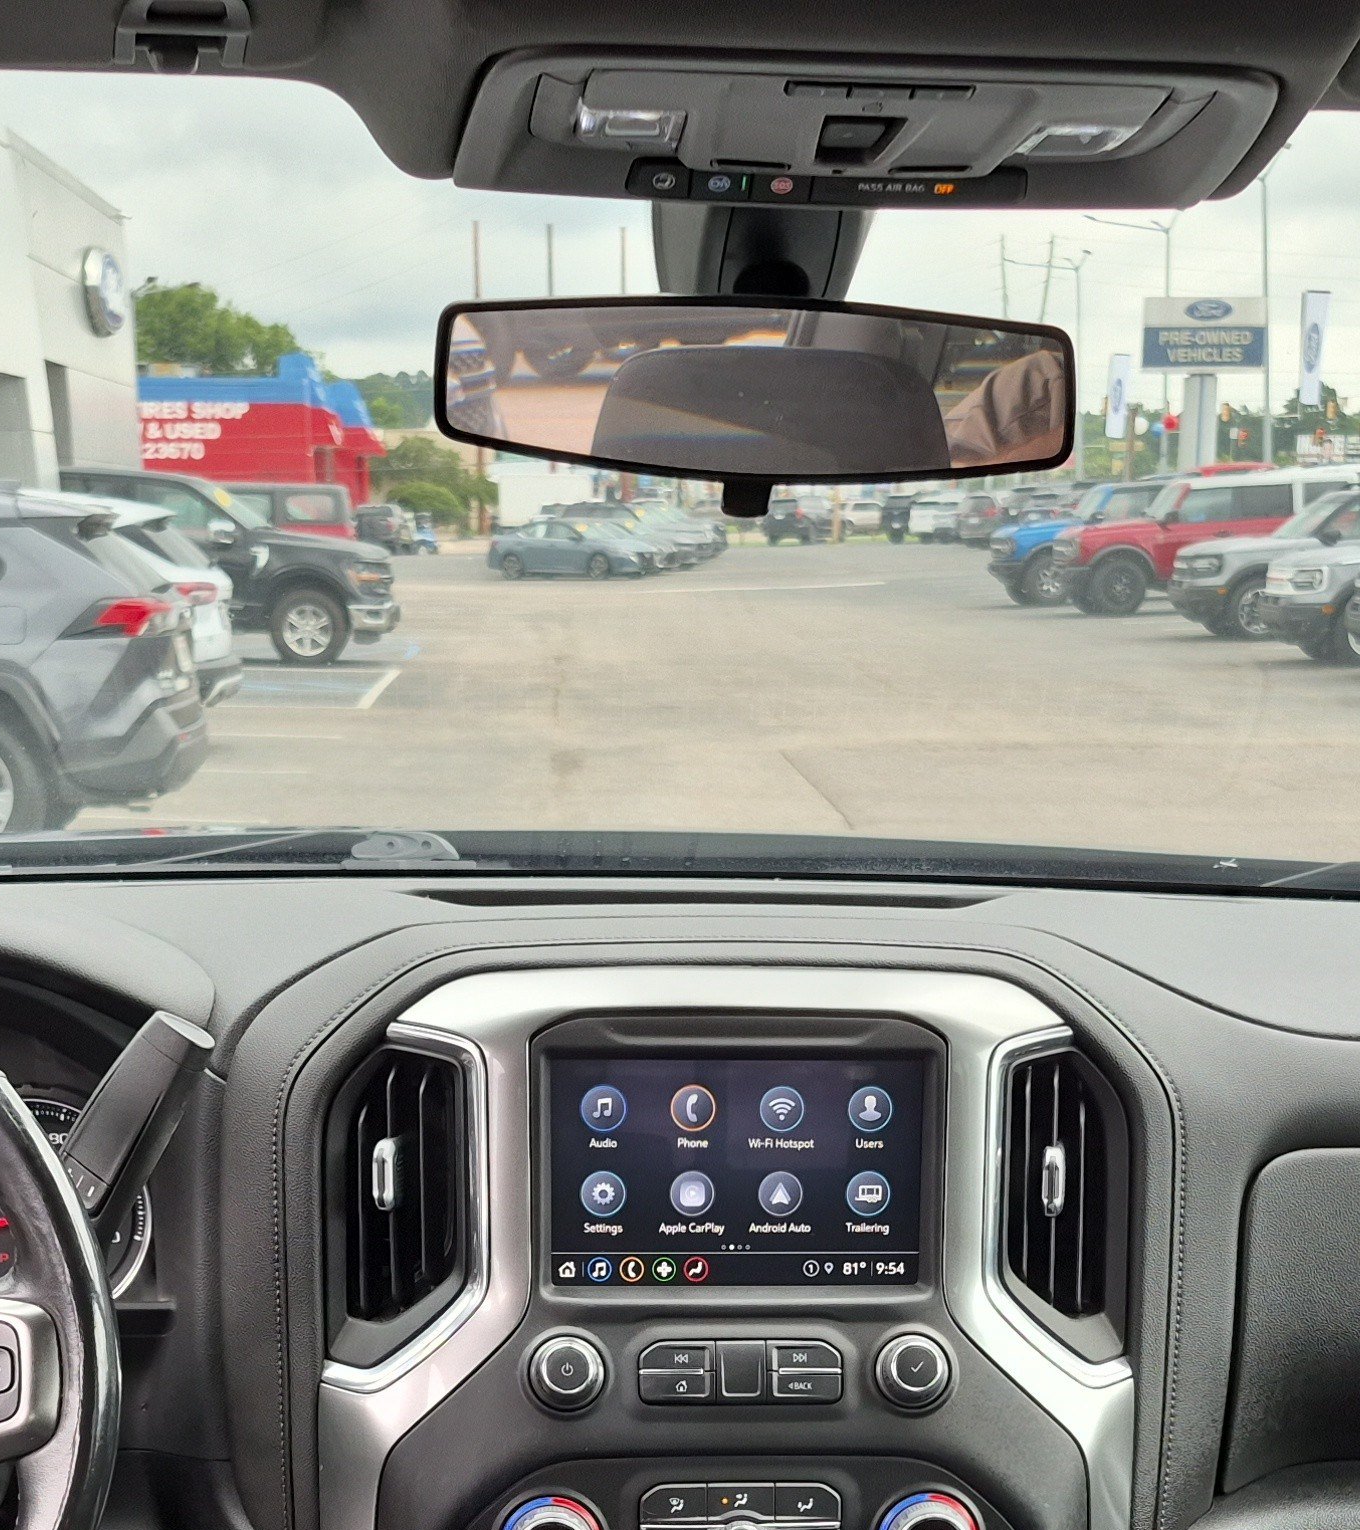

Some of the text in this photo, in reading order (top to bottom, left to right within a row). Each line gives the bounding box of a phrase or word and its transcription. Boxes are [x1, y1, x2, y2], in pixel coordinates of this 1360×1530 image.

[858, 183, 954, 195] PASS AIR BAG OFF
[1158, 331, 1254, 346] PRE-OWNED
[1167, 347, 1245, 363] VEHICLES
[190, 402, 250, 419] SHOP
[163, 422, 221, 440] USED
[589, 1138, 618, 1148] Audio
[677, 1138, 709, 1148] Phone
[748, 1138, 815, 1151] Wi-Fi Hotspot
[855, 1138, 884, 1149] Users
[583, 1222, 623, 1235] Settings
[659, 1222, 725, 1236] Apple CarPlay
[749, 1222, 811, 1233] Android Auto
[845, 1222, 890, 1235] Trailering
[0, 1253, 9, 1263] P
[876, 1262, 905, 1275] 9:54
[794, 1381, 813, 1390] BACK
